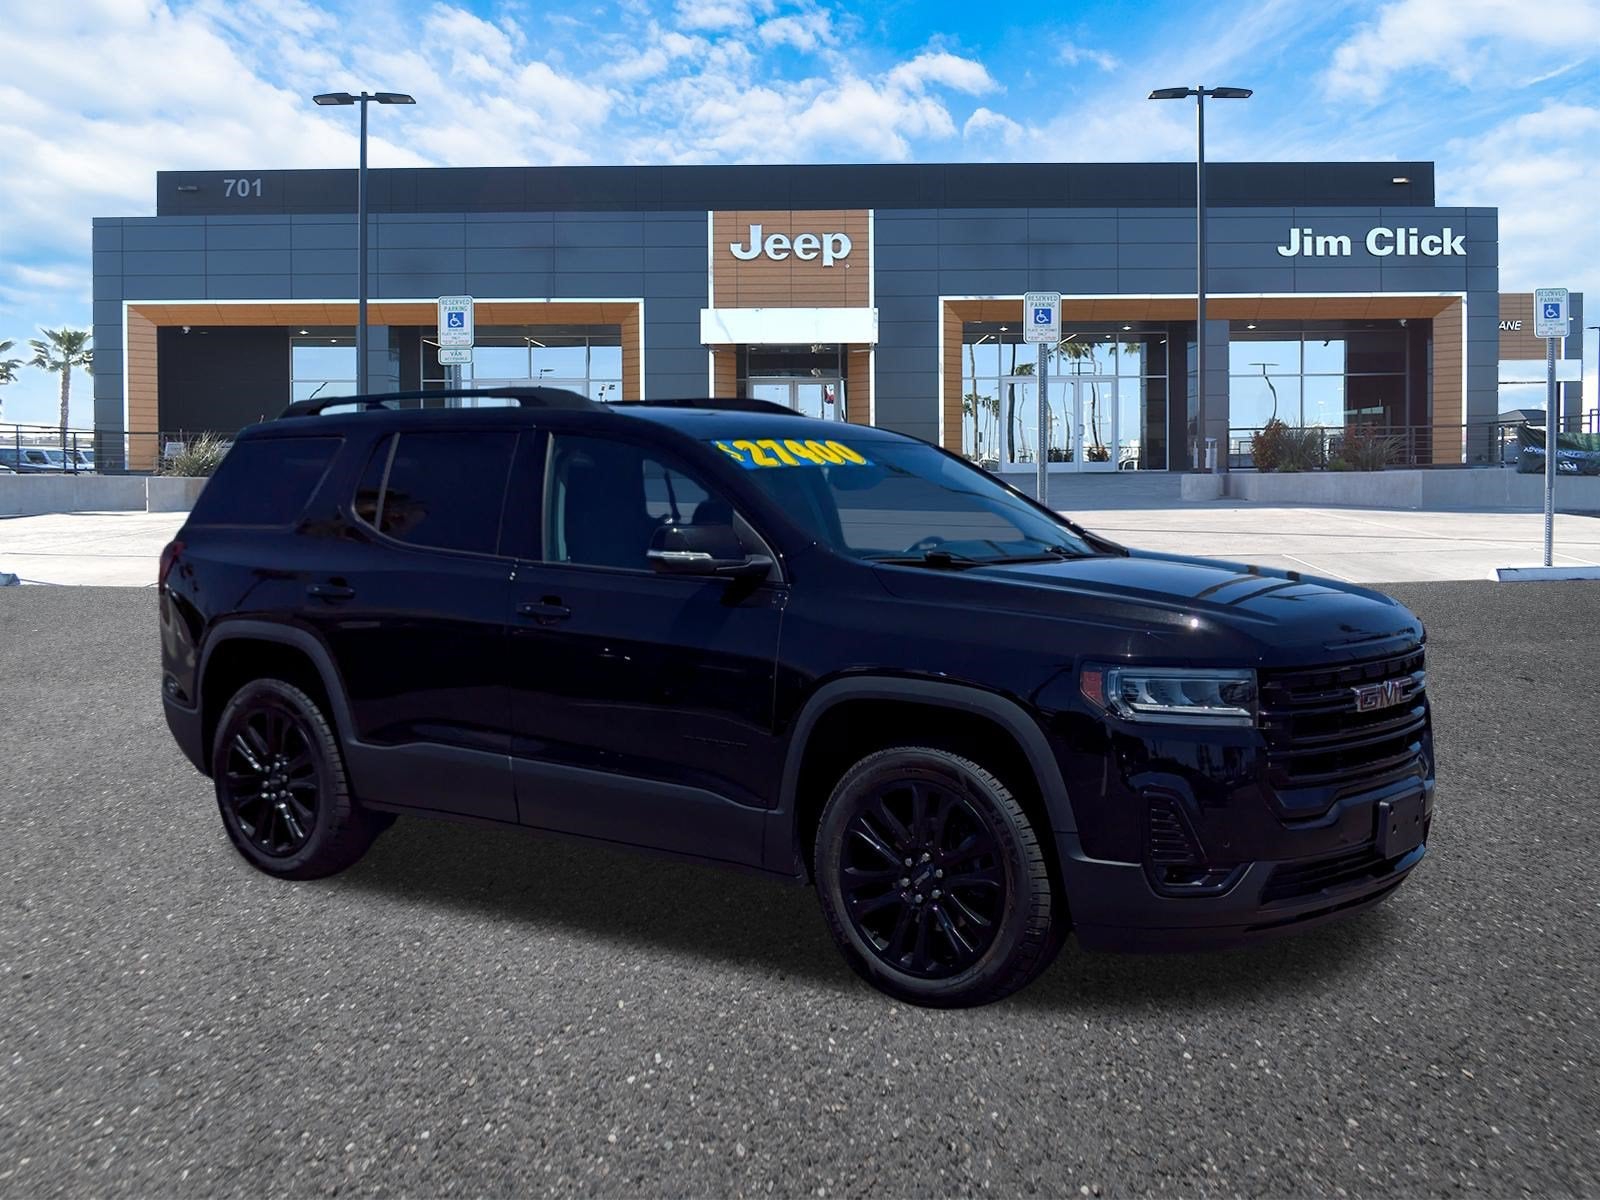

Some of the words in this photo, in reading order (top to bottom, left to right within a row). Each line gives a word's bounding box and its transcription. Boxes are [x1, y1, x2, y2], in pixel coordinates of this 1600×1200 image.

[223, 178, 262, 197] 701
[729, 224, 851, 267] Jeep
[1277, 227, 1352, 257] Jim
[1365, 227, 1467, 257] Click
[1352, 678, 1414, 712] GMC
